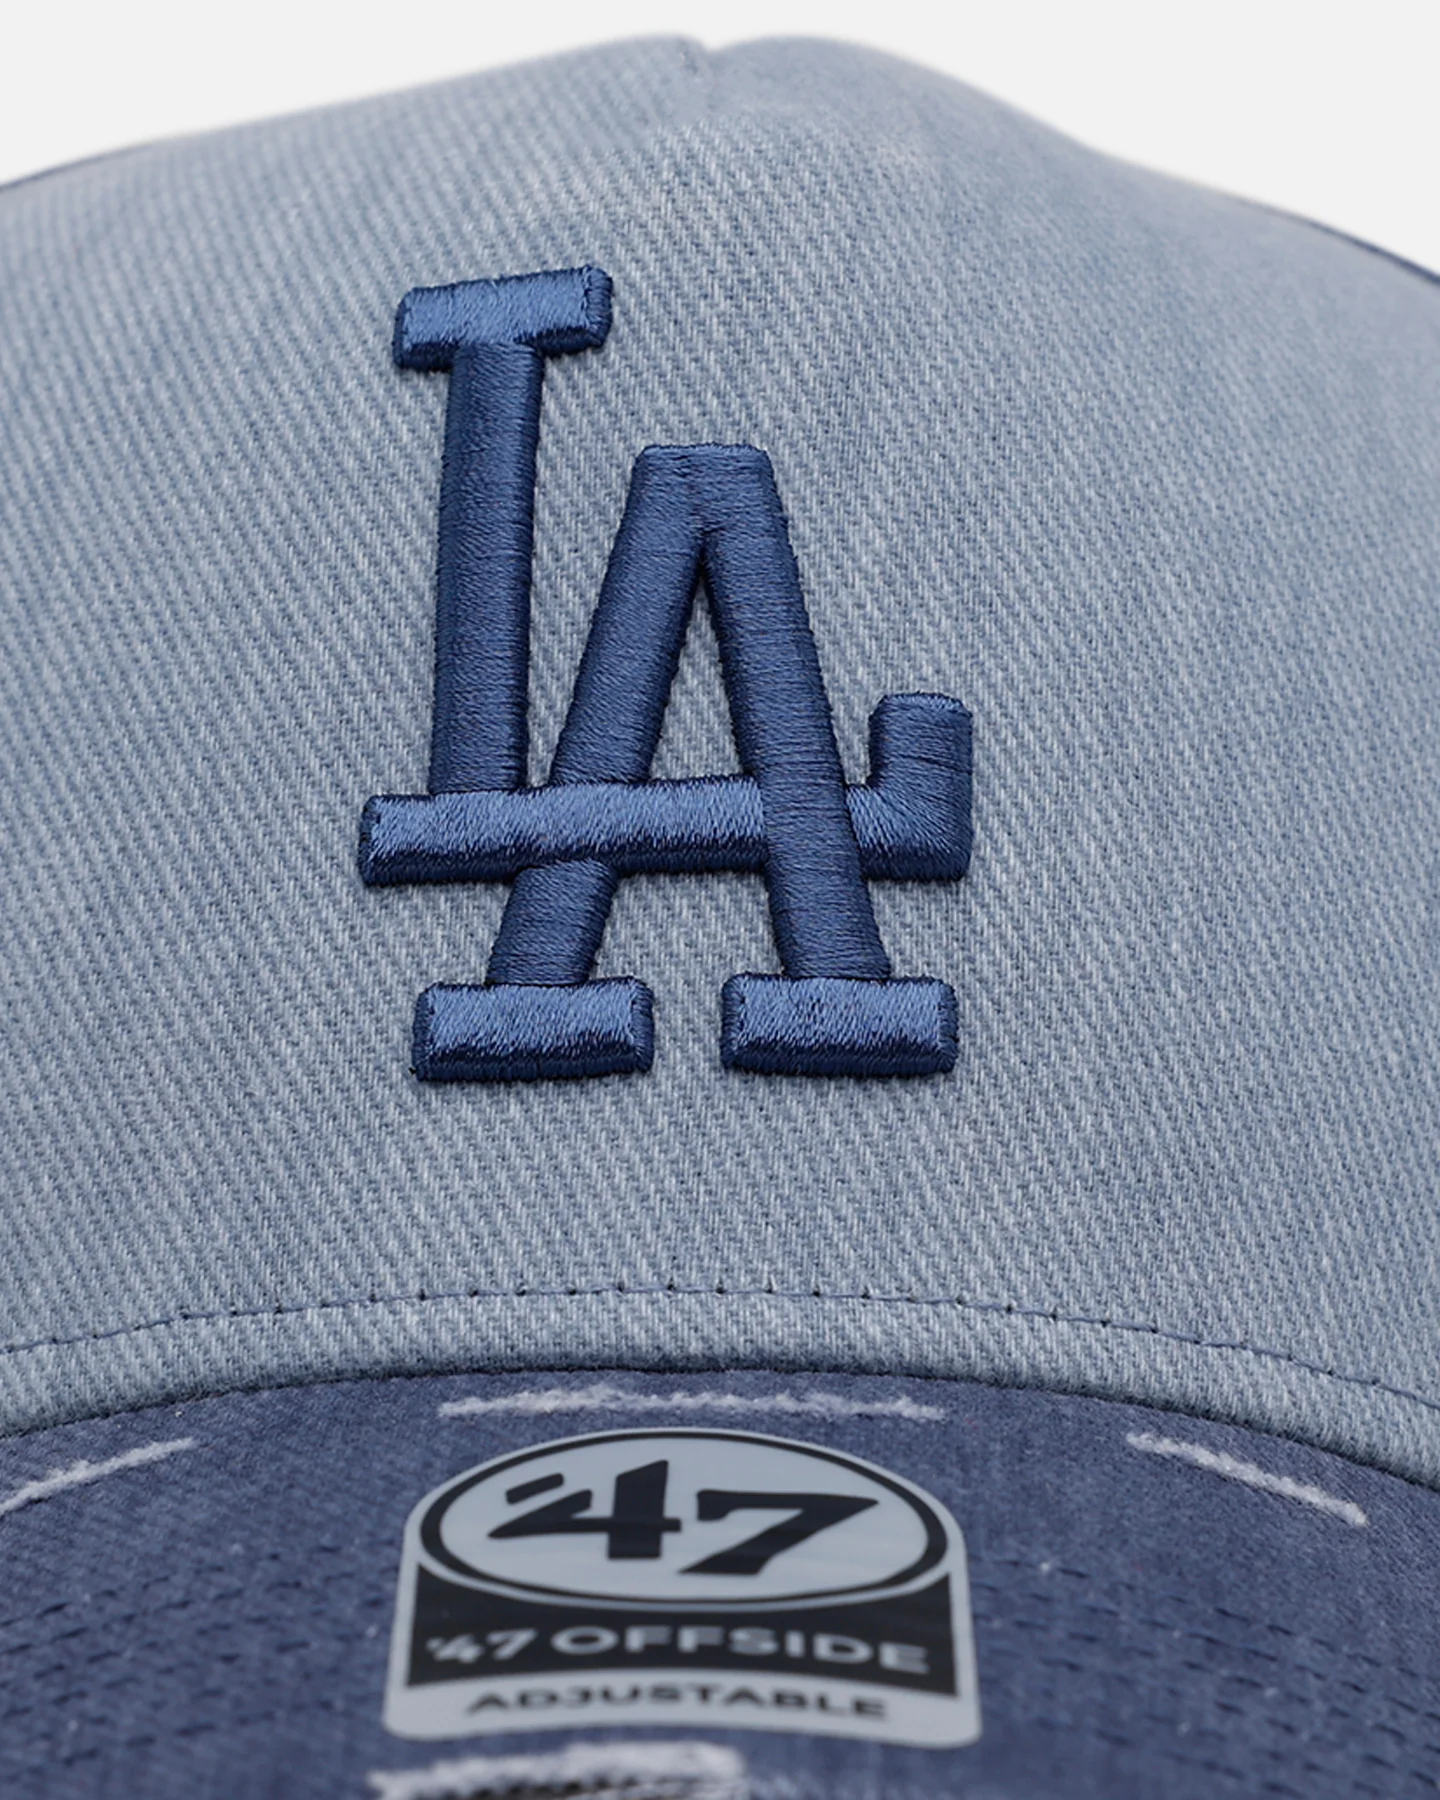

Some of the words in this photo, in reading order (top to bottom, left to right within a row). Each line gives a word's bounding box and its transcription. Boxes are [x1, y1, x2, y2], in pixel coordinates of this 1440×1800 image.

[359, 266, 973, 1081] LA
[550, 1626, 930, 1674] OFFSIDE
[467, 1684, 887, 1717] ADJUSTABLE
